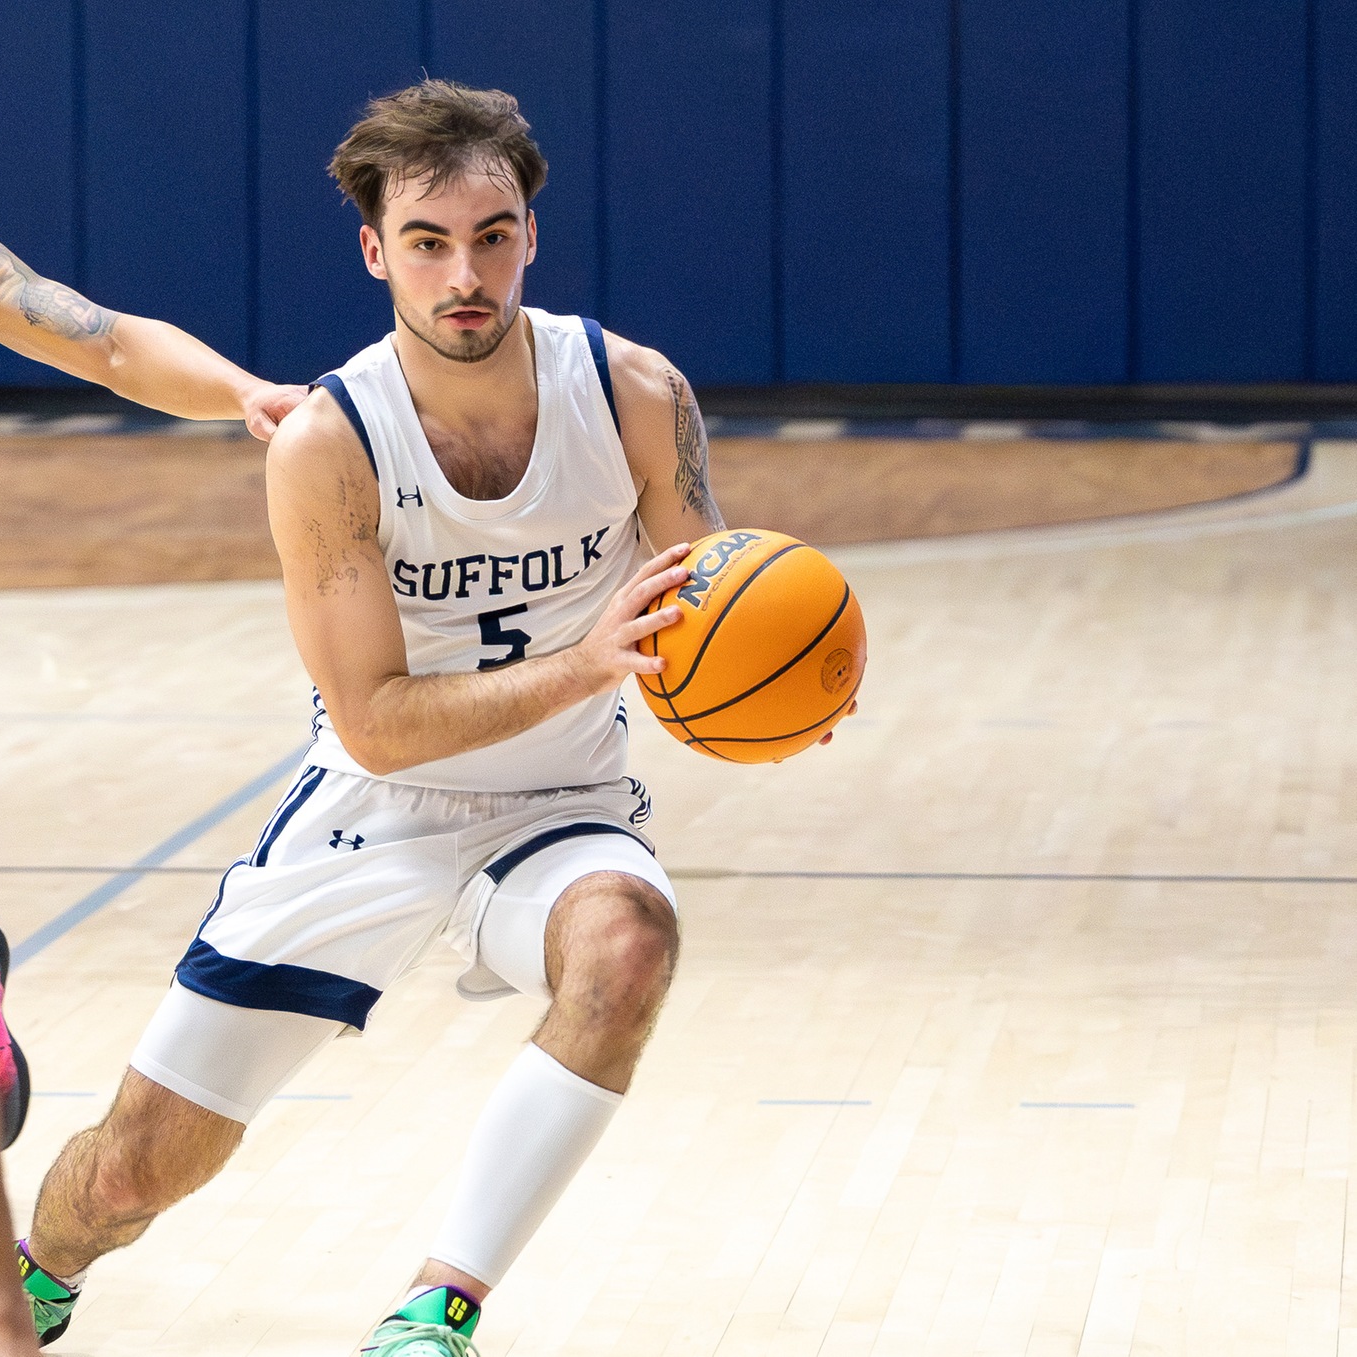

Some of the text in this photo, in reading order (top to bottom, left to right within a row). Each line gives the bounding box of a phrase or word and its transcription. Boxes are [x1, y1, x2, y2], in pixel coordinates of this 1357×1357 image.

[393, 526, 610, 600] SUFFOLK
[677, 532, 762, 608] NCAA
[476, 602, 532, 672] 5
